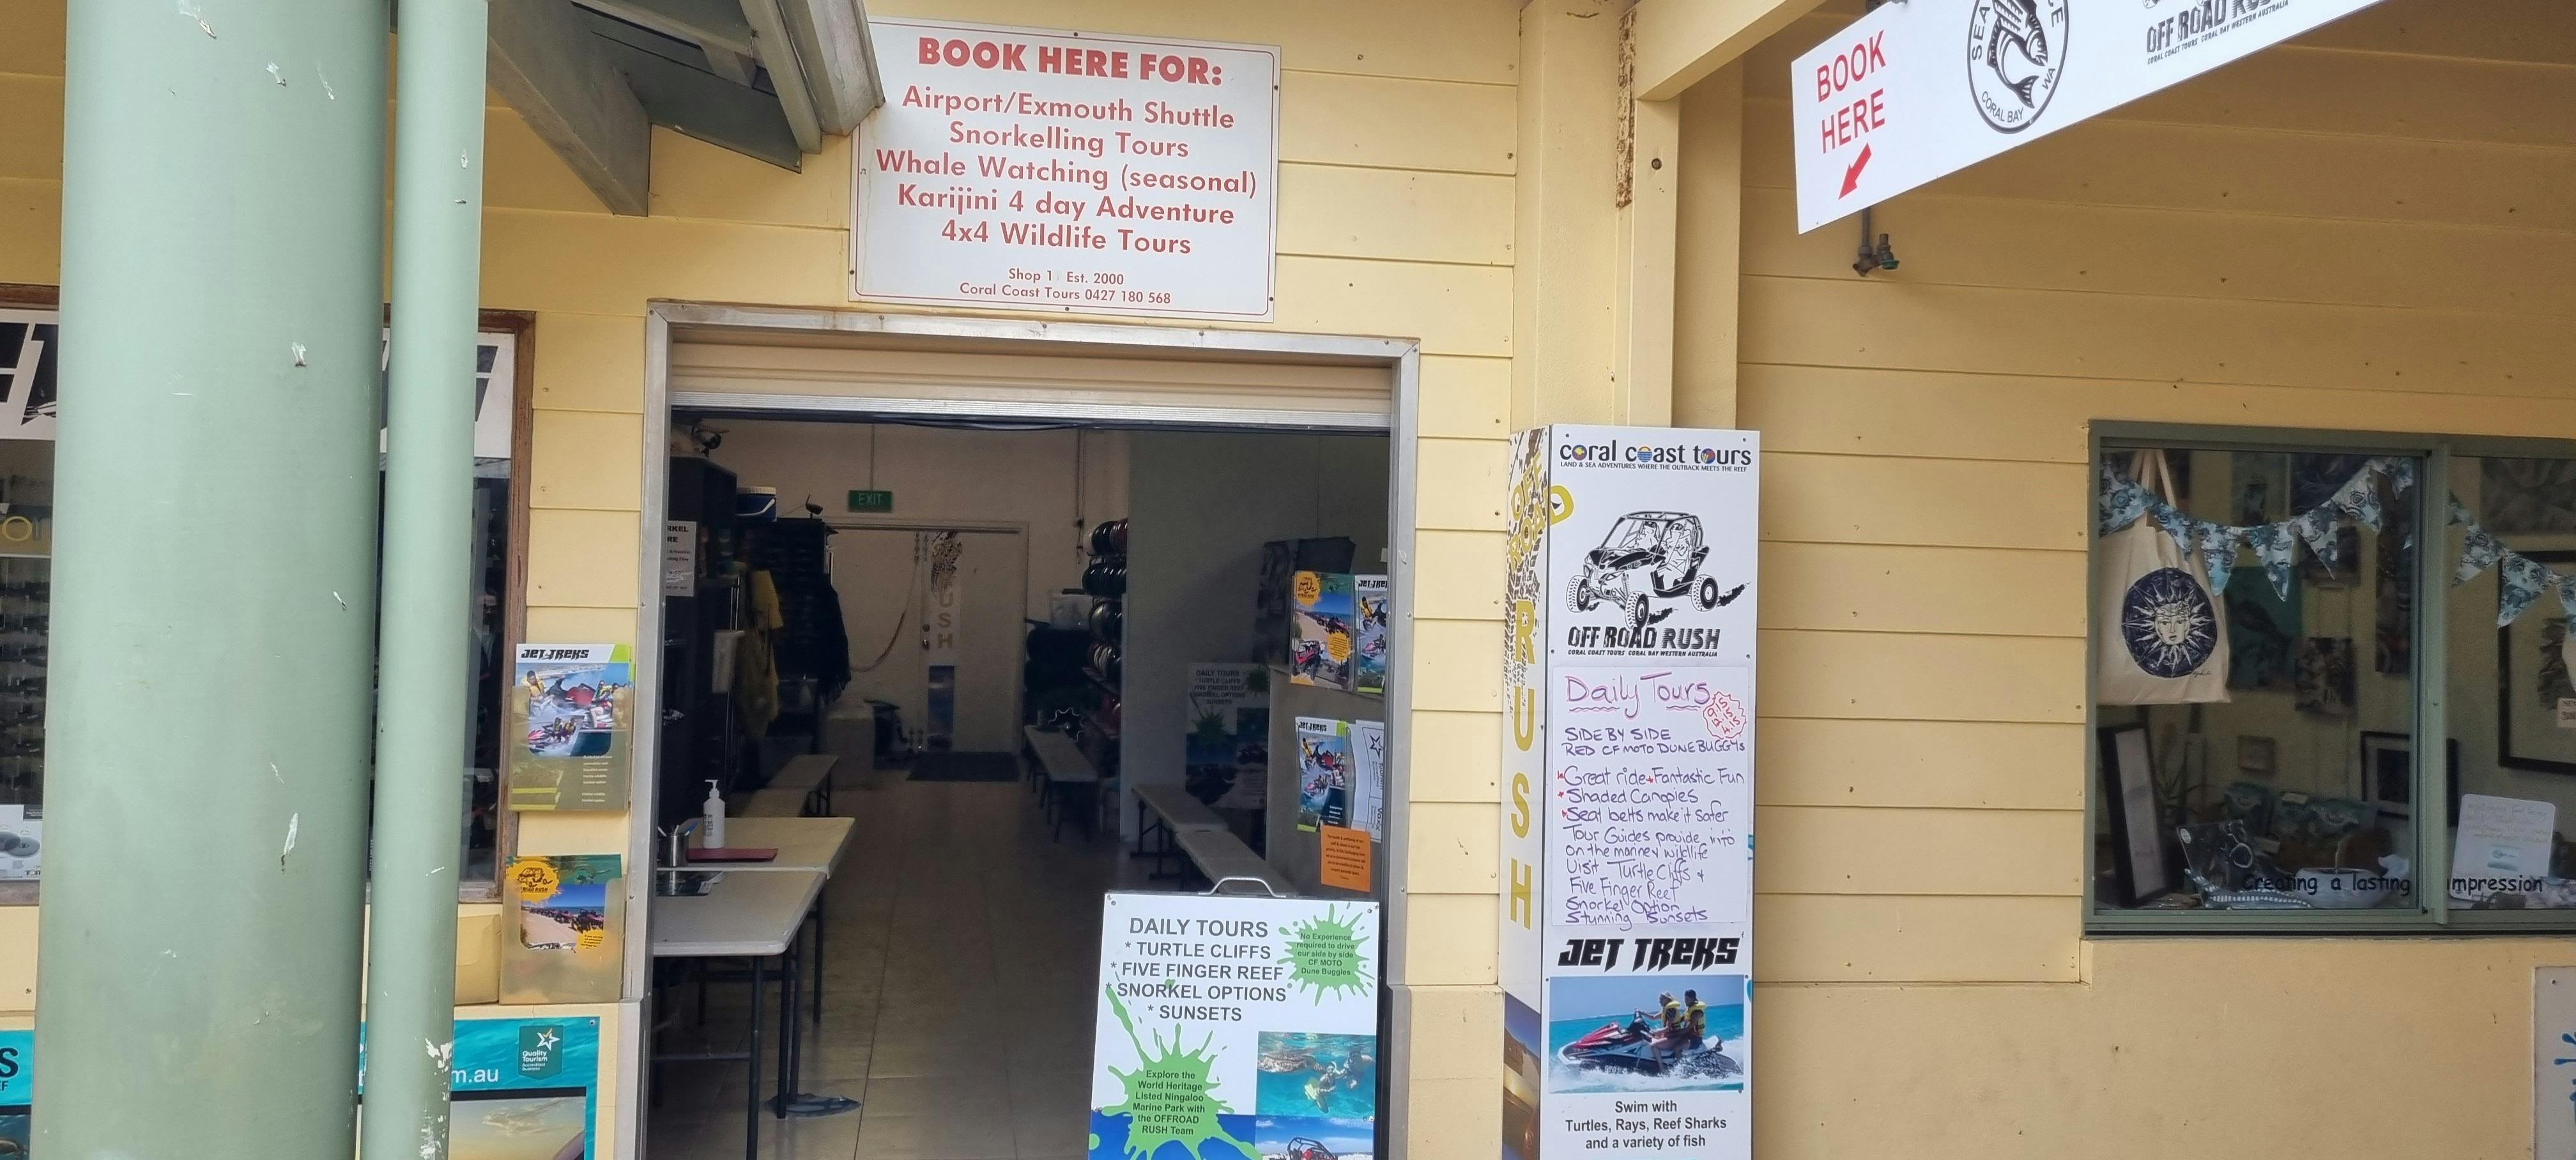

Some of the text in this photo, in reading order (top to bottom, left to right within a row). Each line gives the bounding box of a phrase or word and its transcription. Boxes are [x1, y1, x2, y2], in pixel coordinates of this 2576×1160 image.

[1972, 6, 1991, 61] SEA
[2147, 17, 2174, 53] OFF
[2178, 0, 2227, 42] ROAD
[919, 37, 1222, 86] BOOK HERE FOR:
[1816, 30, 1887, 102] BOOK
[1982, 68, 2056, 123] CORAL BAY WA
[901, 86, 1234, 128] Airport/Exmouth Shuttle
[1821, 88, 1885, 154] HERE
[949, 121, 1189, 158] Snorkelling Tours
[876, 149, 1257, 198] Whale Watching (seasonal)
[898, 184, 1234, 224] Karijini 4 day Adventure
[942, 220, 1191, 255] 4x4 Wildlife Tours
[1009, 268, 1124, 286] Shop 1 Est. 2000
[960, 282, 1170, 305] Coral Coast Tours 0427 180 568
[1560, 439, 1751, 466] coral coast tours
[859, 493, 883, 505] EXIT
[1568, 626, 1721, 649] OFF ROAD RUSH
[1565, 671, 1710, 720] Daily Tours
[1565, 728, 1671, 742] SIDE BY SIDE
[1561, 742, 1696, 757] RED CF DUNE
[1510, 599, 1535, 931] RUSH
[1565, 765, 1744, 786] Great ride Fantastic Fun
[1567, 787, 1698, 809] Shaded Canopies
[1567, 807, 1679, 823] Seat belts make
[1563, 823, 1699, 848] Tour Guides provide
[1588, 843, 1708, 860] the wildlife
[1607, 859, 1653, 881] Turtle
[1657, 857, 1690, 883] Cliffs
[1570, 876, 1681, 906] Five Finger Reef
[2242, 873, 2317, 894] Creating
[2331, 878, 2342, 891] a
[2352, 872, 2411, 896] lasting
[1565, 896, 1680, 915] Snorkel Option
[1130, 917, 1268, 938] DAILY TOURS
[1565, 906, 1708, 931] Stunning Sunsets
[1137, 942, 1271, 959] TURTLE CLIFFS
[1122, 962, 1284, 981] FIVE FINGER REEF
[1117, 982, 1287, 1002] SNORKEL OPTIONS
[1159, 1005, 1242, 1021] SUNSETS
[1146, 1070, 1195, 1080] Explore the
[1138, 1081, 1202, 1092] World Heritage
[1133, 1103, 1205, 1113] Marine Park with
[1136, 1092, 1204, 1103] Listed Ningaloo
[1615, 1100, 1677, 1113] Swim with
[1138, 1114, 1199, 1124] the OFFROAD
[1565, 1117, 1727, 1133] Turtles, Rays, Reef Sharks
[1142, 1126, 1193, 1135] RUSH Team
[1586, 1134, 1705, 1150] and a variety of fish
